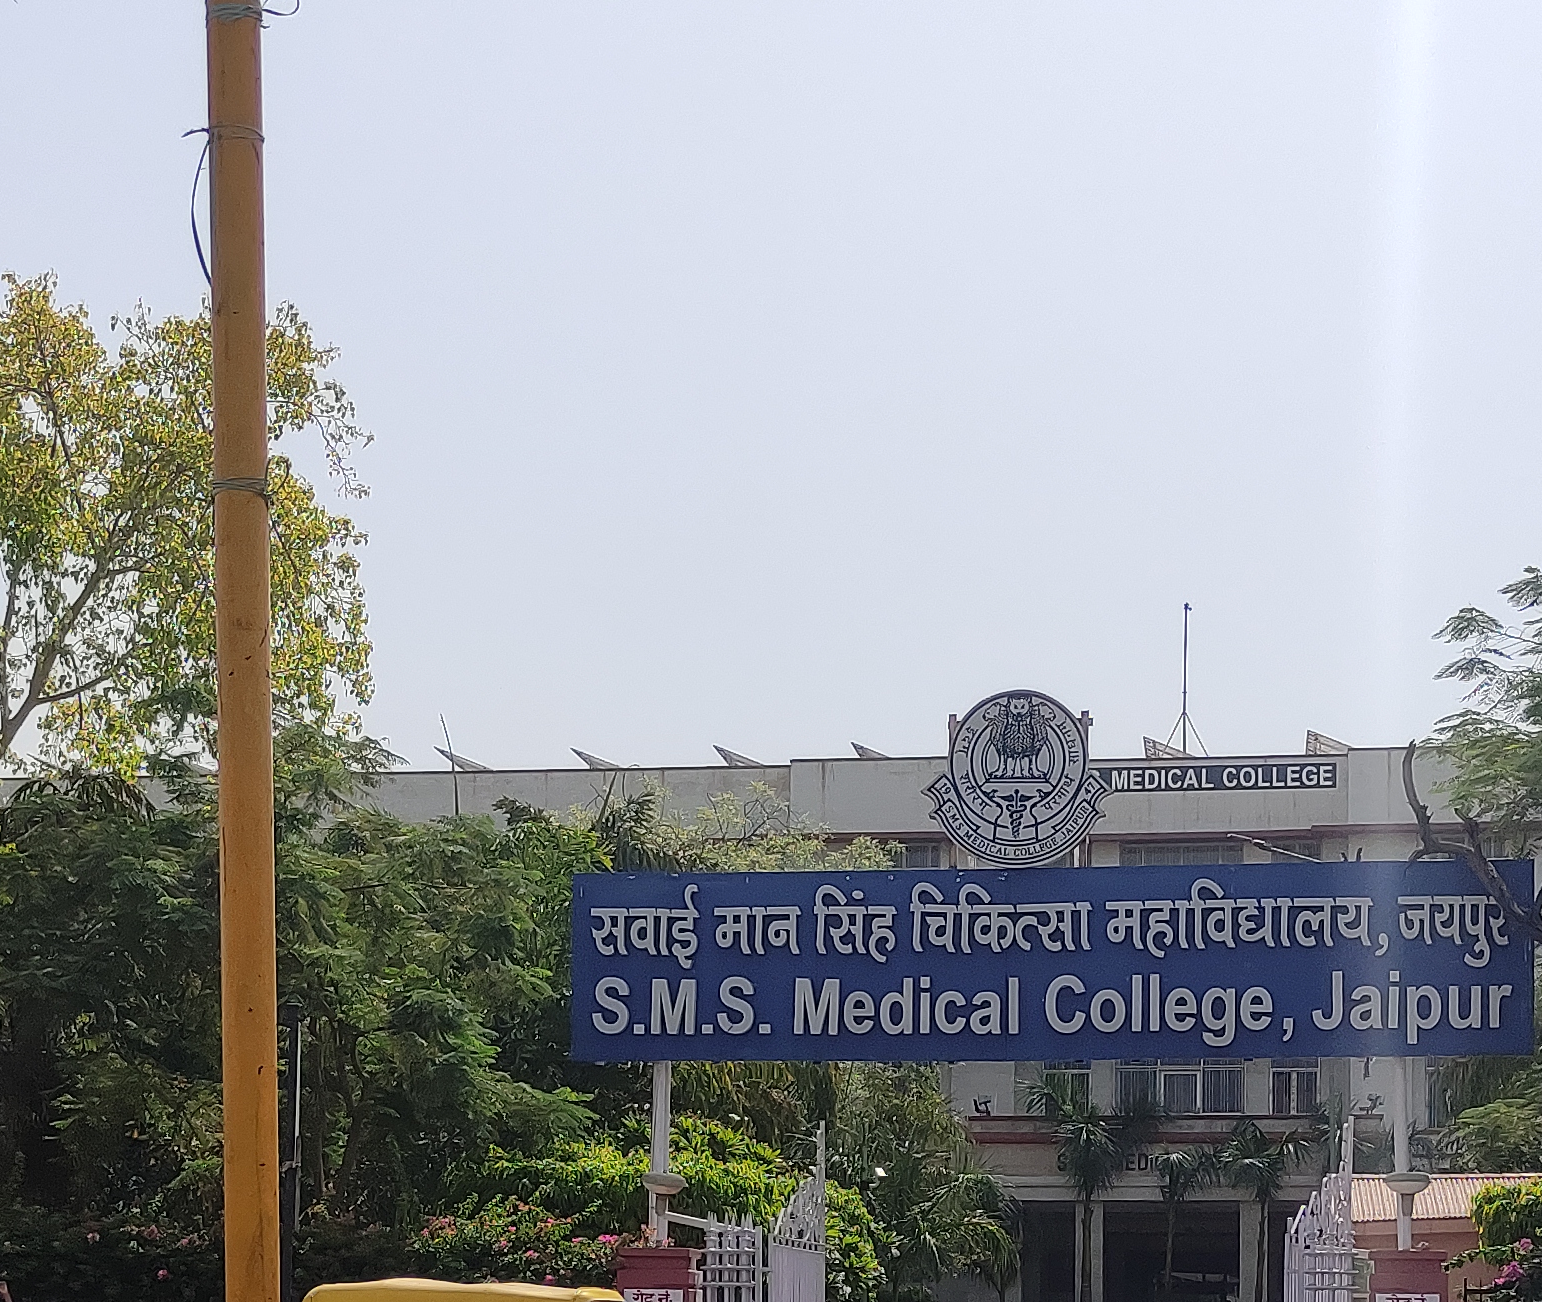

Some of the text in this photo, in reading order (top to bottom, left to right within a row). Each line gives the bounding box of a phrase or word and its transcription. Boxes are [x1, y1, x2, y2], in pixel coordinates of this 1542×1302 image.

[938, 782, 952, 795] 19
[1083, 781, 1096, 796] 47
[1111, 765, 1333, 790] MEDICAL COLLEGE
[963, 830, 1010, 857] MEDICAL
[591, 878, 1511, 968] सवाई मान सिंह चिकित्सा महाविद्यालय, जयपुर
[591, 970, 1513, 1047] S.M.S. Medical College, Jaipur
